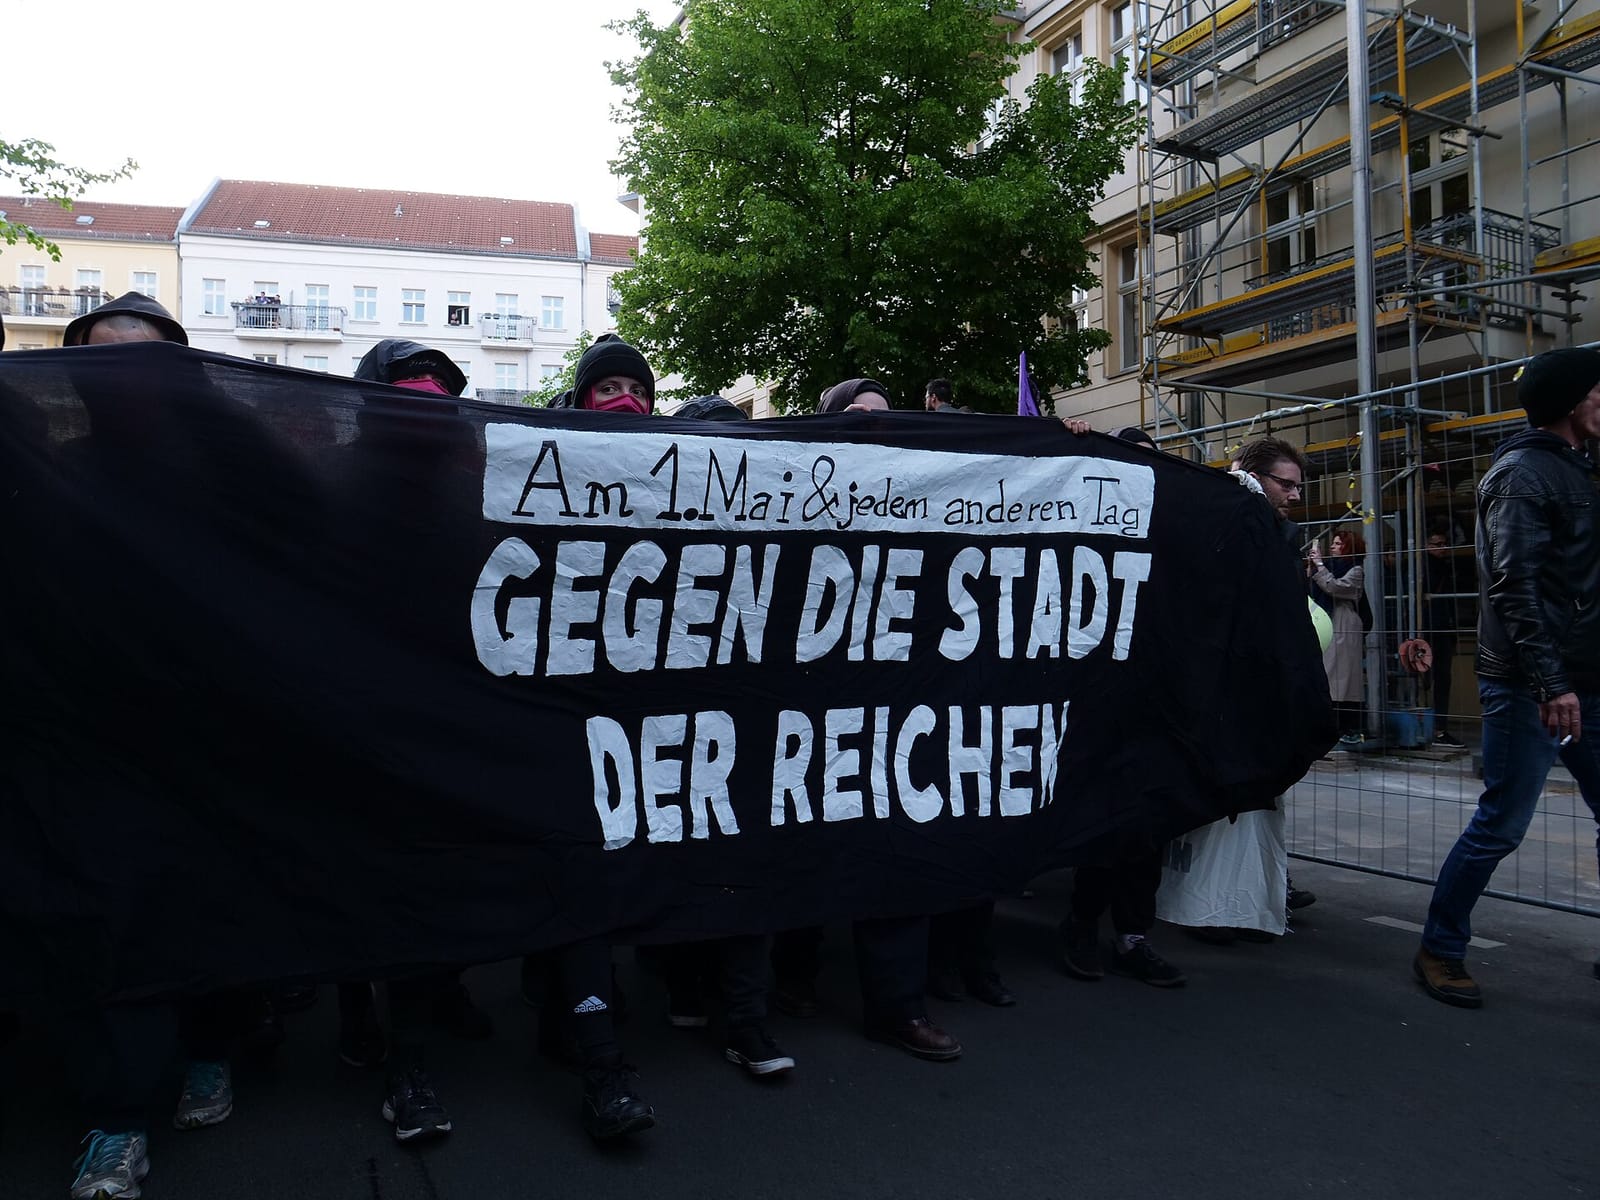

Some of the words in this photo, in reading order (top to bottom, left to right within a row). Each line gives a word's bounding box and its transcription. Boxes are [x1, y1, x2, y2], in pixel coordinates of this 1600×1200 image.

[511, 440, 635, 518] Am
[943, 478, 1077, 525] anderen
[1083, 476, 1139, 537] Tag
[470, 536, 780, 677] GEGEN
[796, 544, 924, 664] DIE
[938, 545, 1153, 662] STADT
[586, 710, 741, 851] DER
[770, 700, 1070, 827] REICHEN
